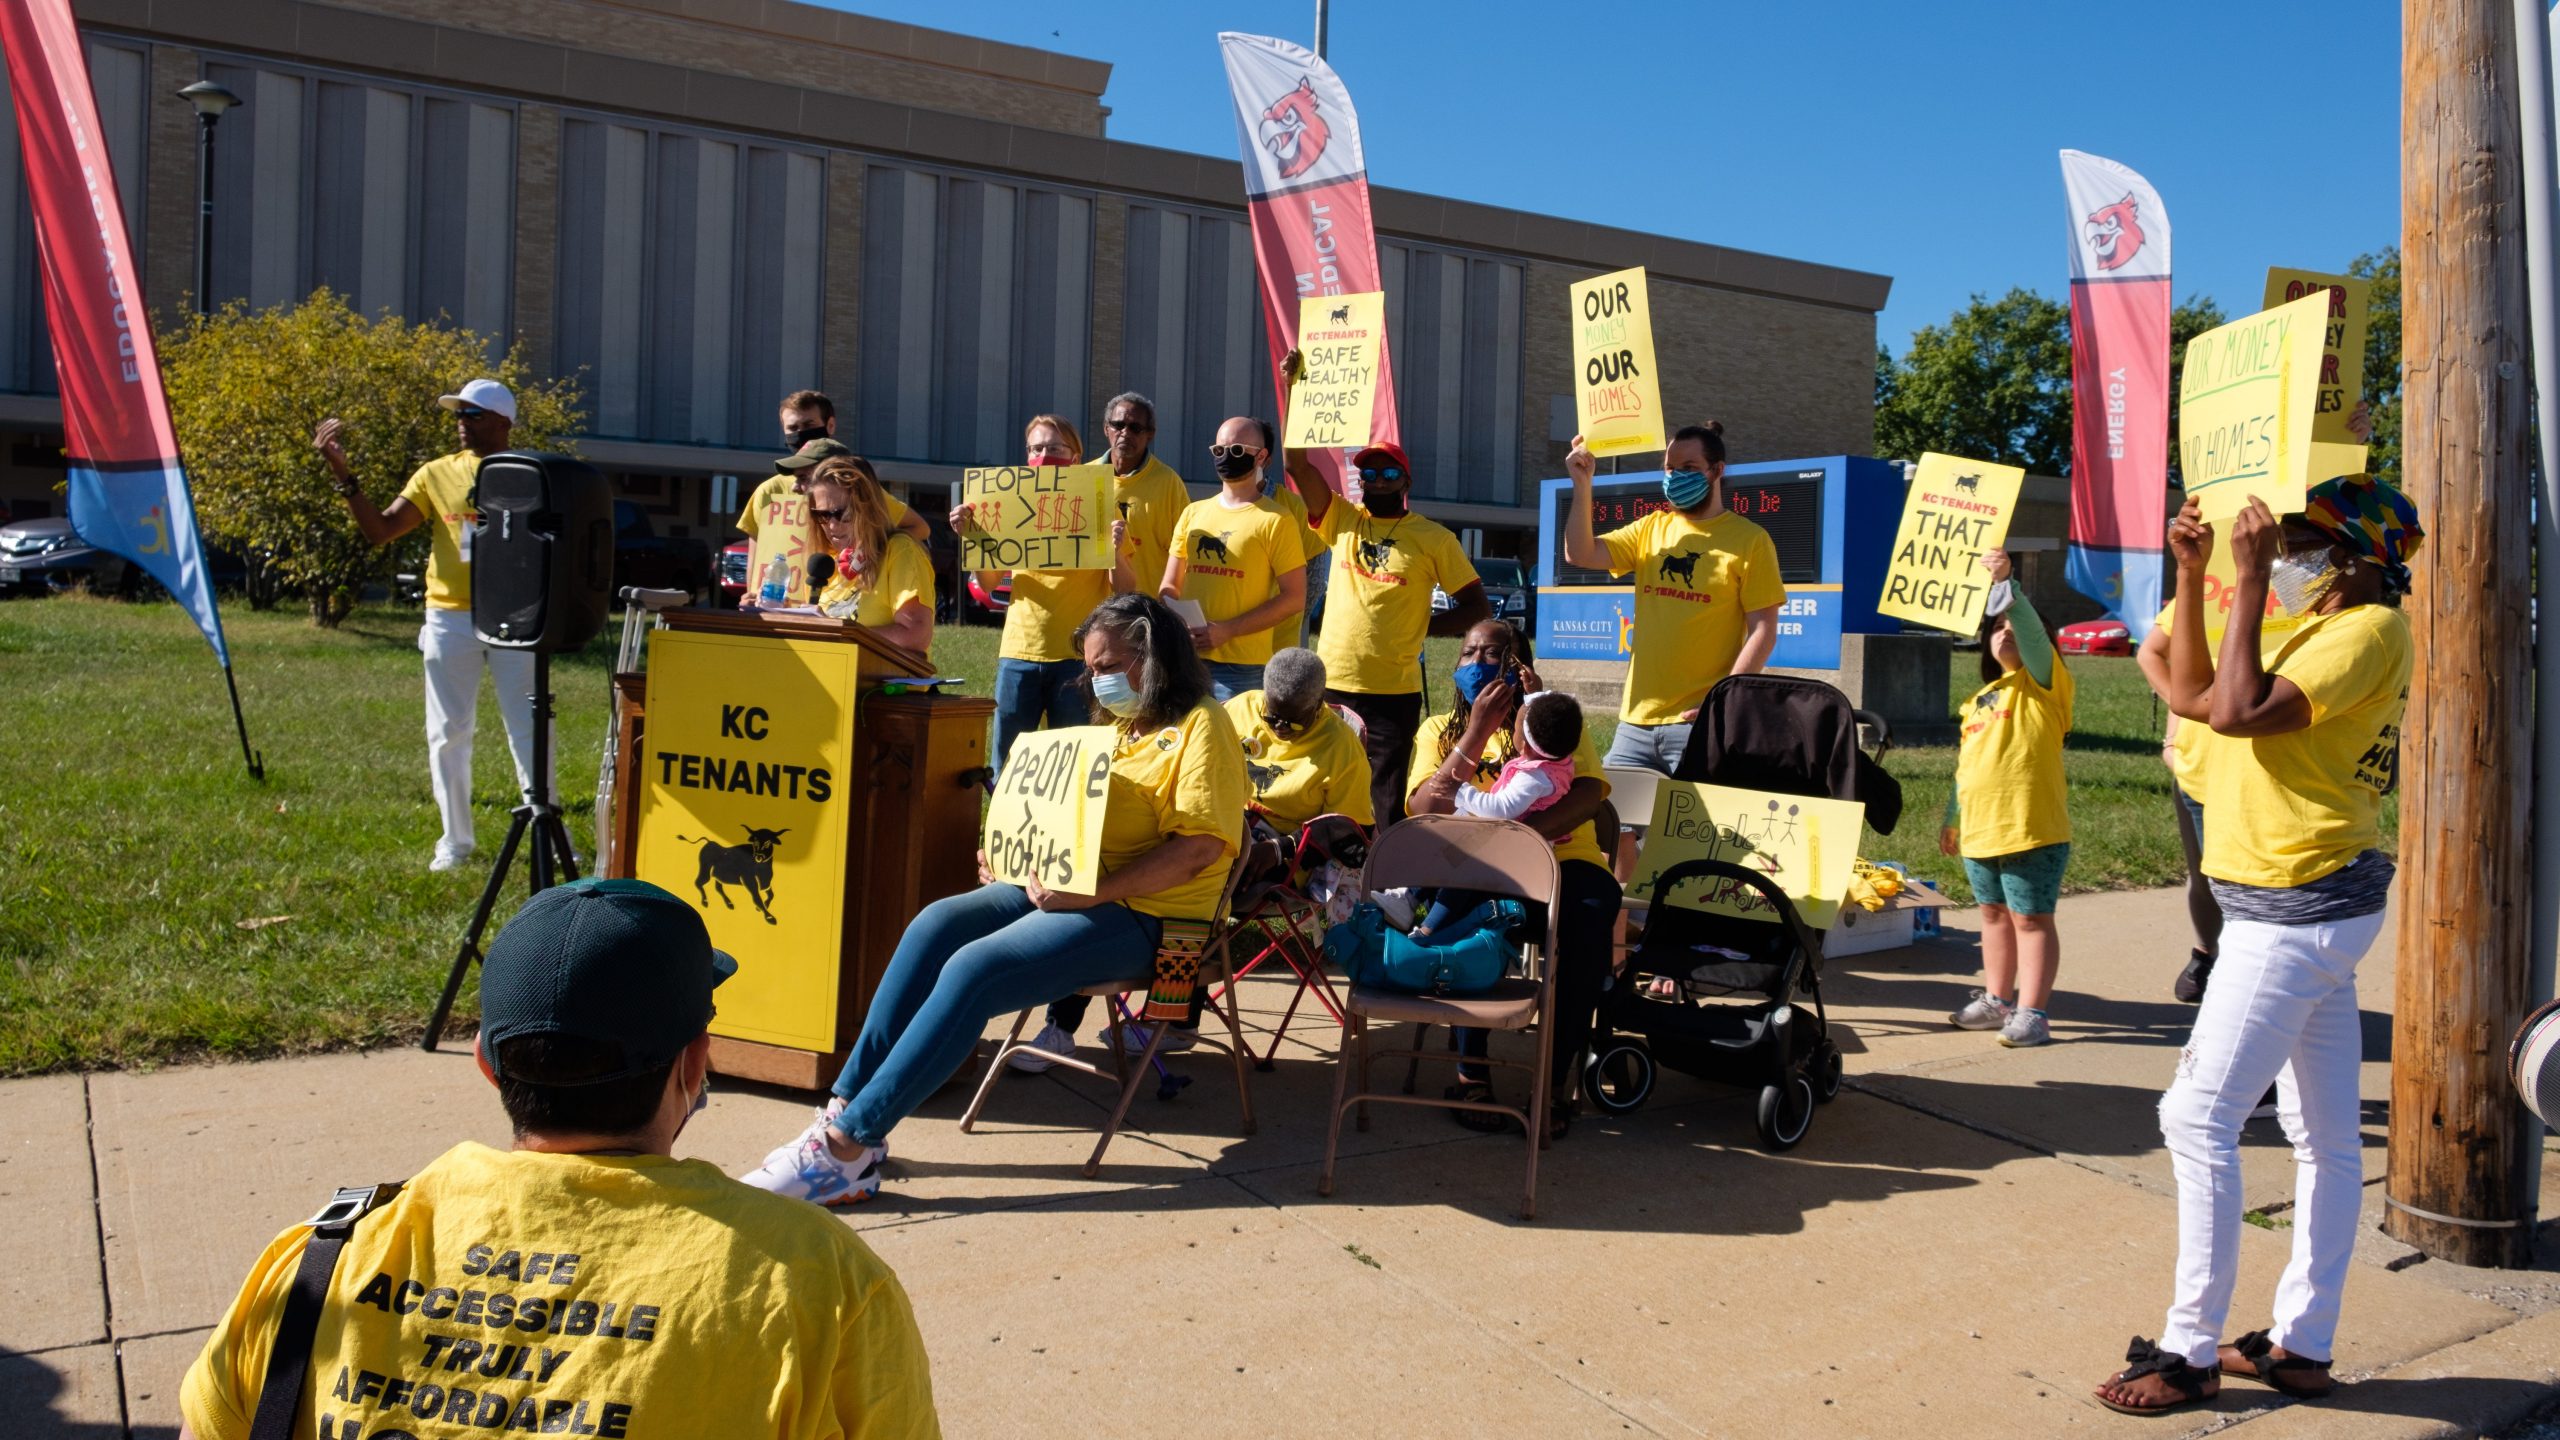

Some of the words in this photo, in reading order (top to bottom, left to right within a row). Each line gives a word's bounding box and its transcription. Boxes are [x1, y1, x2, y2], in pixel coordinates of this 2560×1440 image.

[1584, 282, 1631, 321] OUR
[1306, 332, 1320, 341] KC
[1321, 329, 1368, 341] TENANTS
[1585, 317, 1627, 345] MONEY
[1309, 345, 1362, 366] SAFE
[1586, 349, 1639, 386] OUR
[2185, 338, 2213, 394] OUR
[2218, 314, 2292, 382] MONEY
[1300, 366, 1371, 387] HEALTHY
[1303, 389, 1360, 408] HOMES
[1588, 381, 1642, 416] HOMES
[1314, 410, 1347, 425] FOR
[1304, 427, 1345, 444] ALL
[2205, 414, 2275, 479] HOMES
[967, 466, 1067, 495] PEOPLE
[1615, 503, 1624, 520] a
[1733, 491, 1749, 513] to
[1759, 490, 1780, 512] be
[1922, 492, 1939, 504] KC
[1941, 496, 1998, 516] TENANTS
[1916, 509, 1993, 548] THAT
[963, 535, 1090, 568] PROFIT
[1897, 539, 1983, 577] AIN'T
[1193, 564, 1244, 579] TENANTS
[1655, 586, 1712, 604] TENANTS
[1887, 574, 1982, 618] RIGHT
[1553, 620, 1587, 632] KANSAS
[1590, 619, 1613, 633] CITY
[1553, 641, 1577, 649] PUBLIC
[721, 704, 769, 741] KC
[657, 751, 832, 803] TENANTS
[1664, 790, 1762, 860] People
[991, 824, 1073, 886] Profits
[461, 1243, 581, 1286] SAFE
[354, 1271, 661, 1343] ACCESSIBLE
[419, 1334, 571, 1384] TRULY
[331, 1365, 633, 1439] AFFORDABLE
